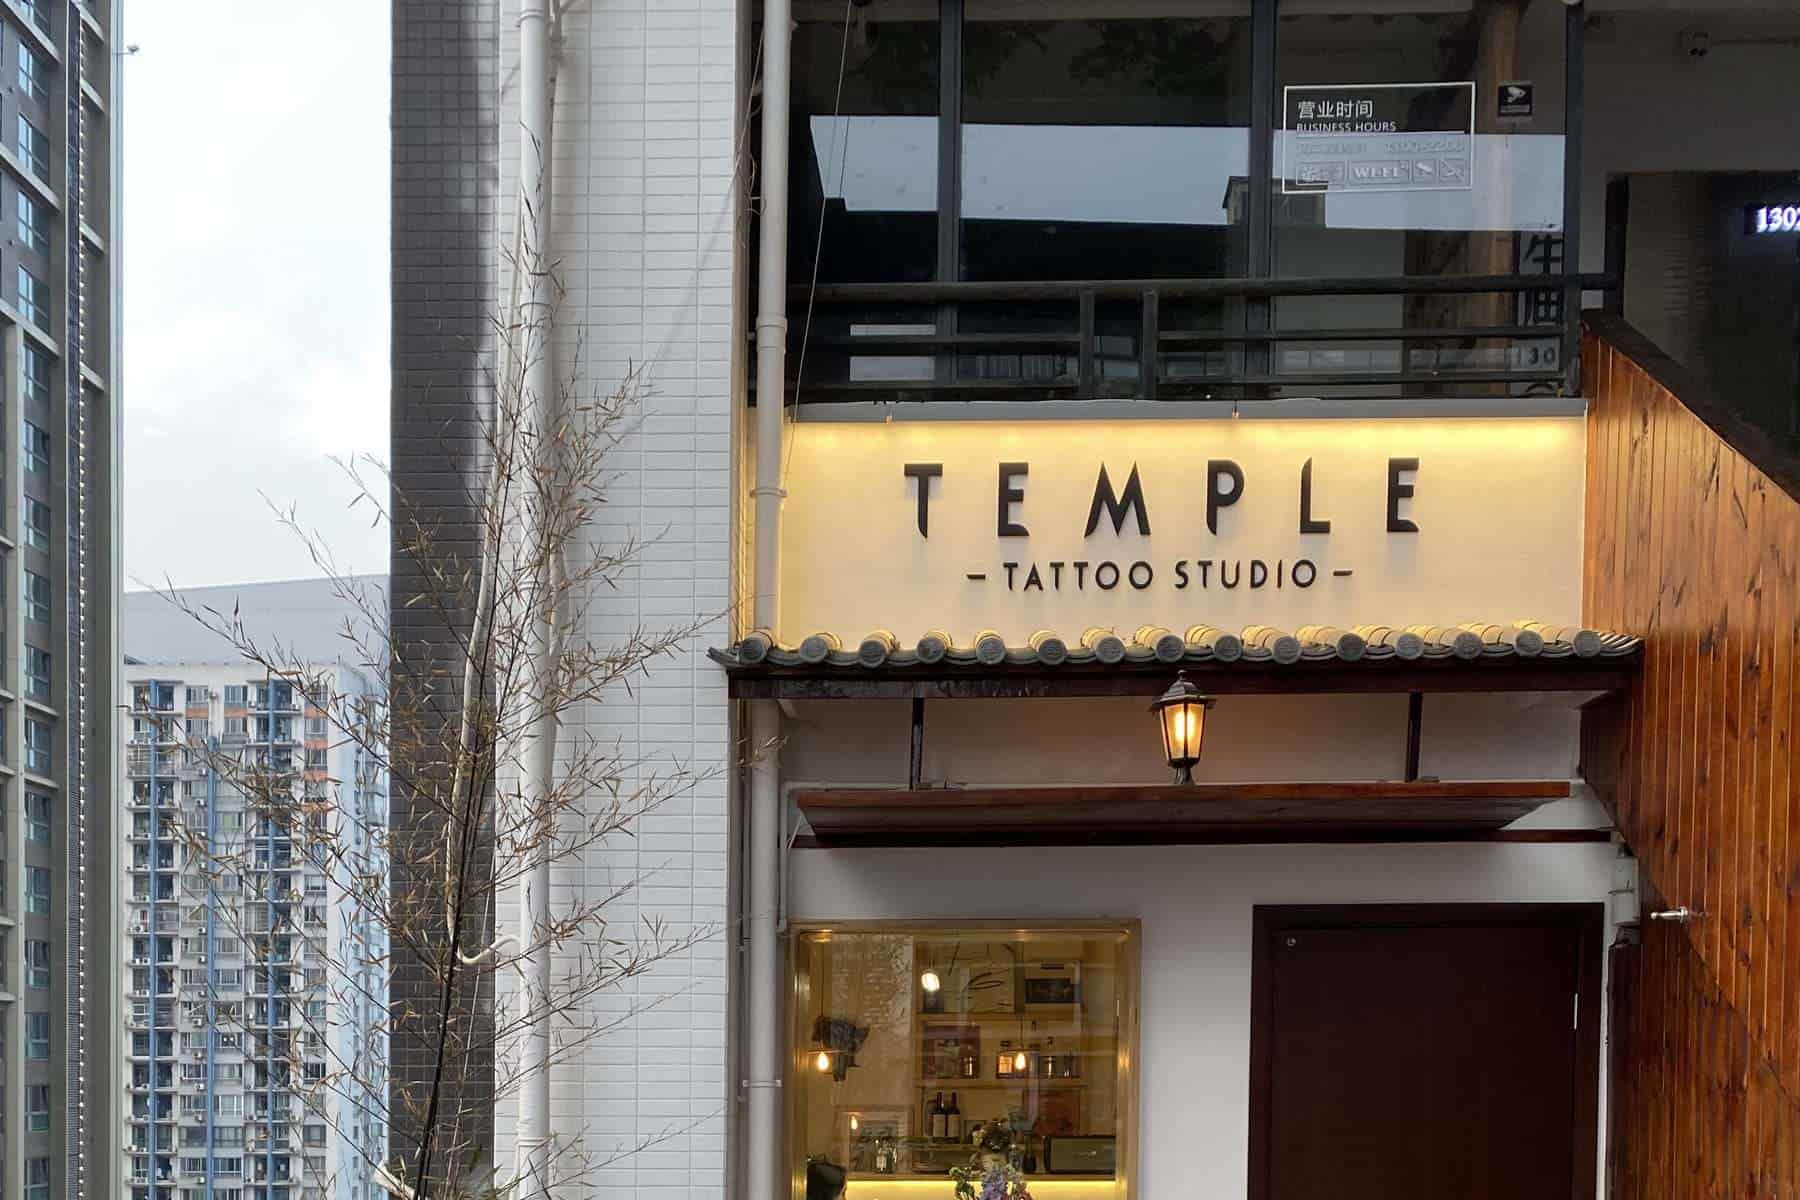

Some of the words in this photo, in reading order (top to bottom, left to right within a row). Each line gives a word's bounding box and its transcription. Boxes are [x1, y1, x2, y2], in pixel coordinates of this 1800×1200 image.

[1297, 100, 1374, 119] 营业时间
[1296, 122, 1351, 134] BUSINESS
[1355, 120, 1397, 132] HOURS
[903, 457, 1420, 539] TEMPLE
[1003, 561, 1154, 591] TATTOO
[1175, 558, 1317, 590] STUDIO
